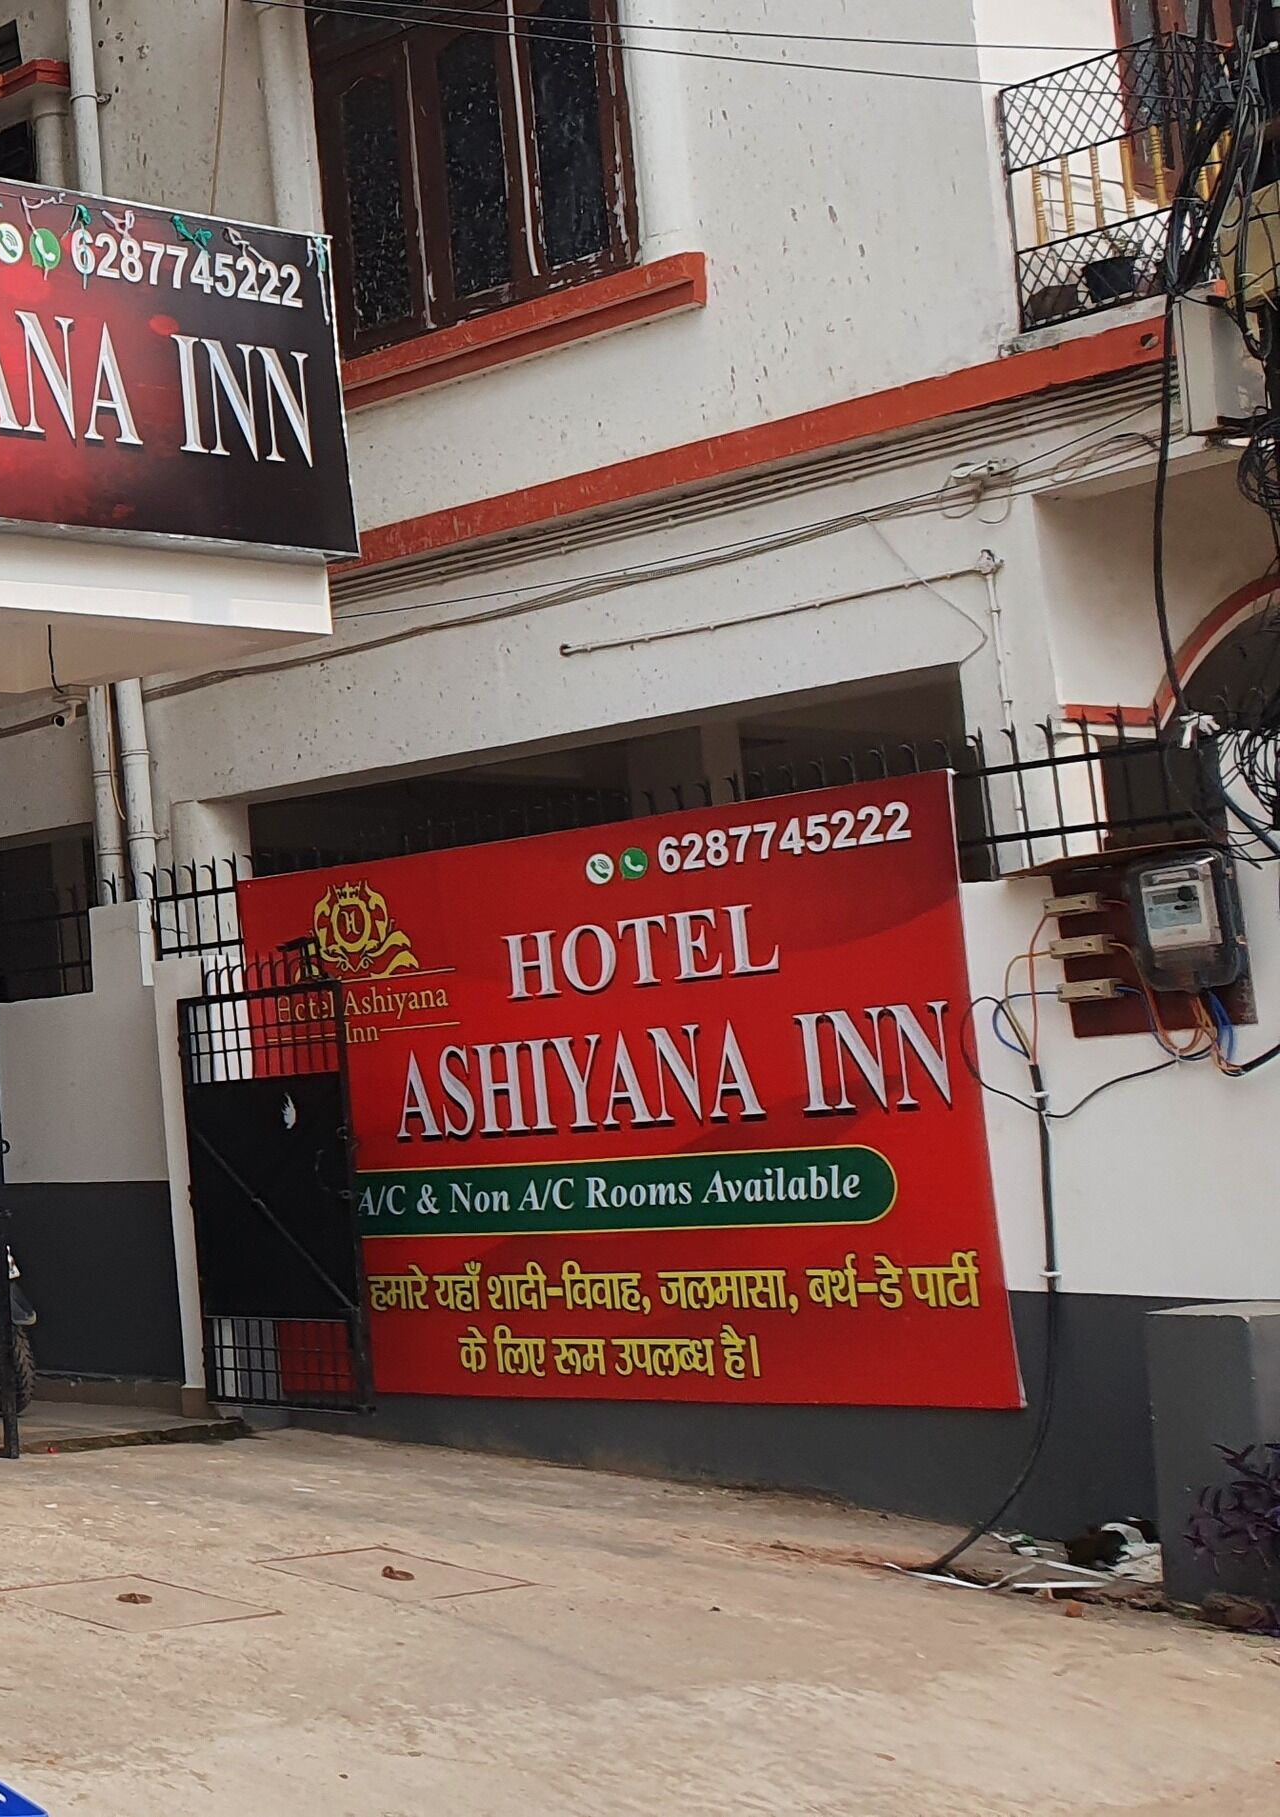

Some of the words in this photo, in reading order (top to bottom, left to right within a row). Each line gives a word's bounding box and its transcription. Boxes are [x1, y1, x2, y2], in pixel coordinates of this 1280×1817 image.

[71, 230, 304, 309] 6287745222
[171, 333, 313, 468] INN
[657, 800, 912, 875] 6287745222
[501, 903, 782, 1003] HOTEL
[344, 985, 449, 1020] Ashiyana
[344, 1020, 380, 1044] Inn
[397, 1018, 767, 1142] ASHIYANA
[793, 999, 956, 1116] INN
[357, 1183, 407, 1217] A/C
[416, 1182, 441, 1215] &
[449, 1181, 511, 1214] Non
[517, 1177, 575, 1212] A/C
[585, 1176, 692, 1210] Rooms
[701, 1164, 862, 1204] Available
[367, 1264, 430, 1312] हमारे
[432, 1260, 482, 1312] यहाँ
[657, 1268, 800, 1315] जलमासा,
[805, 1252, 904, 1309] बर्थ-डे
[908, 1250, 981, 1308] पार्टी
[458, 1325, 488, 1374] के
[493, 1324, 546, 1378] लिए
[551, 1337, 607, 1376] रूम
[611, 1337, 716, 1377] उपलब्ध
